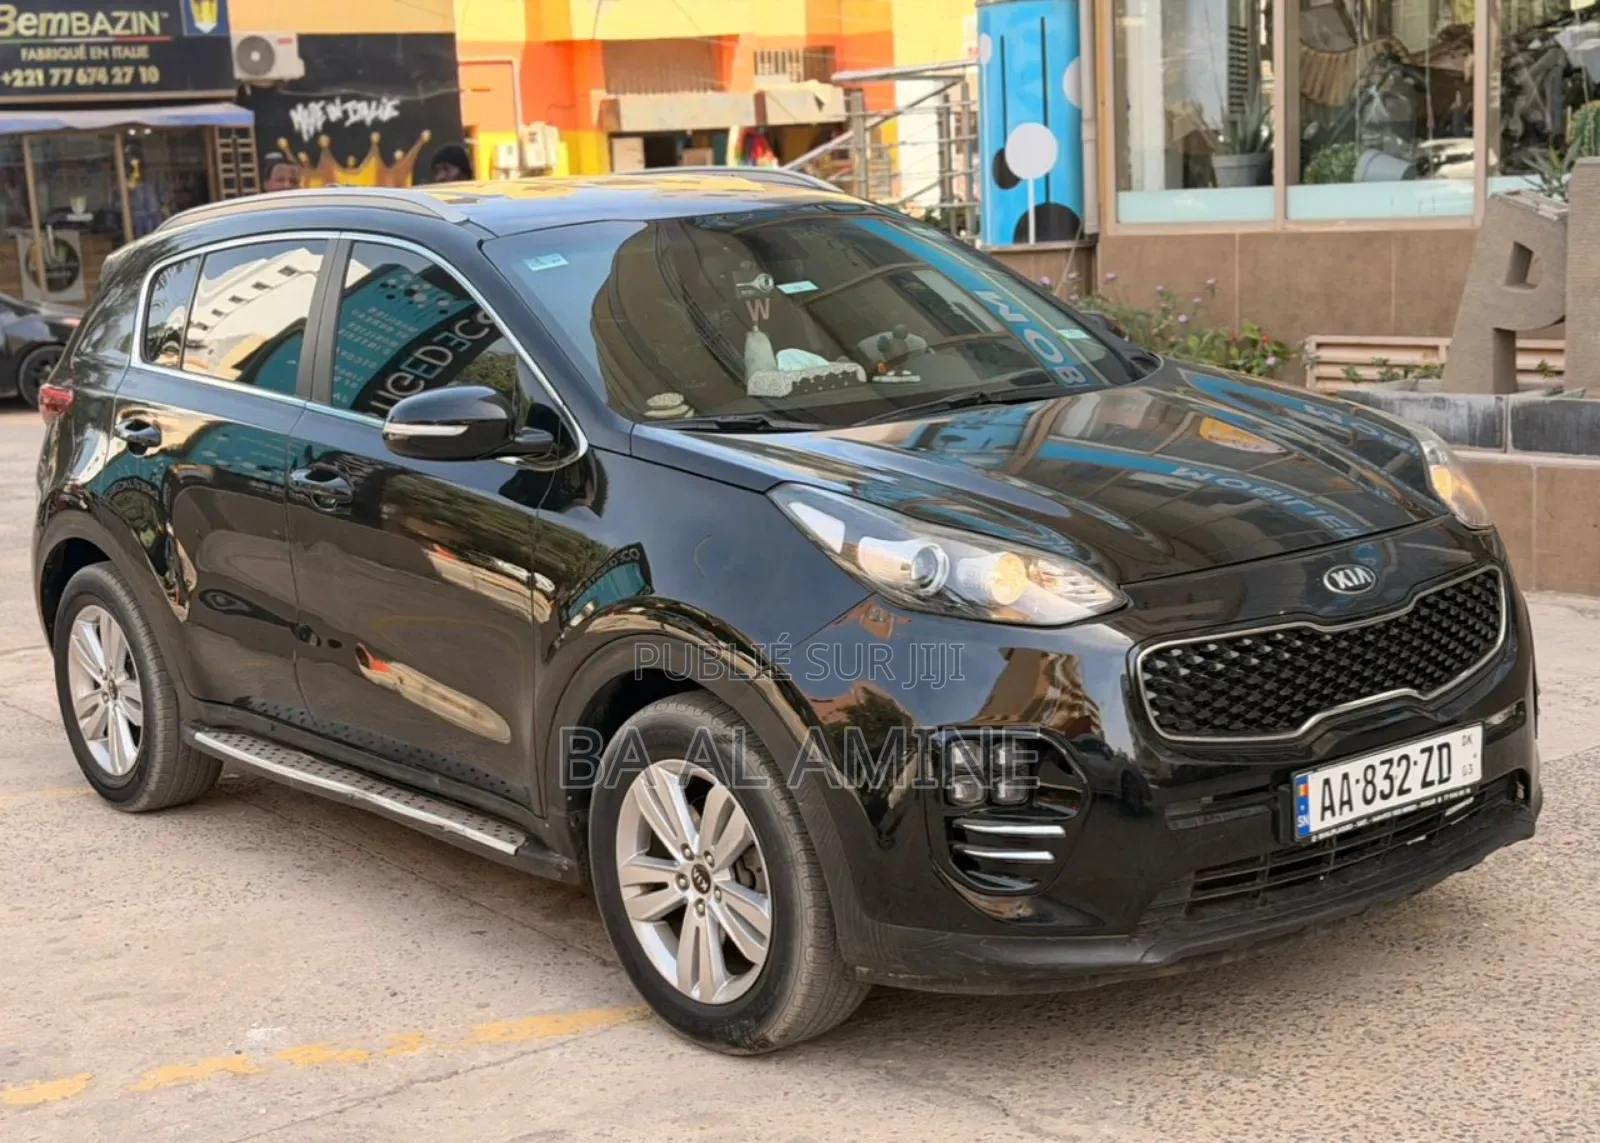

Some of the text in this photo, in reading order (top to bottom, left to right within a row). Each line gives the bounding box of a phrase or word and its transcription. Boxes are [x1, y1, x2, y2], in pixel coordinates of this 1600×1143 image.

[21, 44, 150, 61] FABRIQUÉ EN ITALIE
[1, 68, 45, 88] +221
[49, 67, 74, 87] 77
[111, 66, 135, 86] 27
[138, 65, 160, 84] 10
[1329, 566, 1374, 590] KIA
